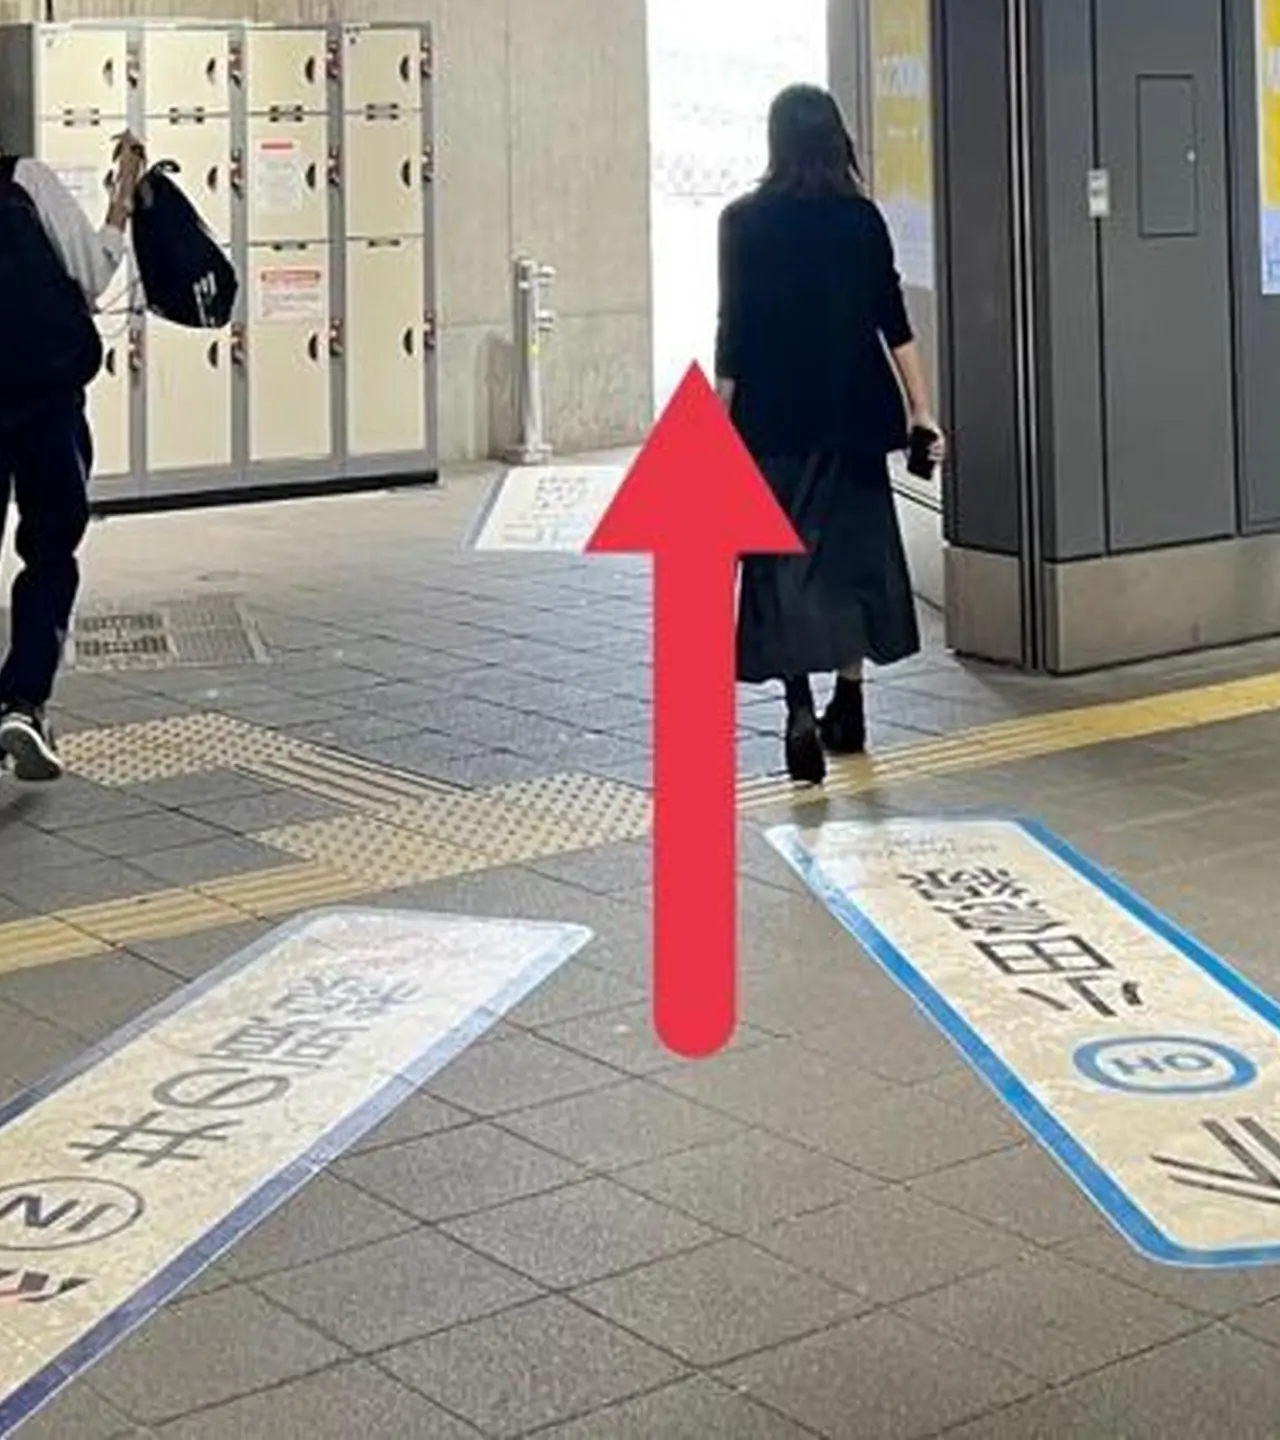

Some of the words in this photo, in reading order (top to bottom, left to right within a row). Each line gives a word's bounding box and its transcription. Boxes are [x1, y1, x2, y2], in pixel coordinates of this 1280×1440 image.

[896, 866, 1145, 1018] 小田急線
[66, 974, 422, 1169] 井の頭線
[1110, 1051, 1215, 1077] OH
